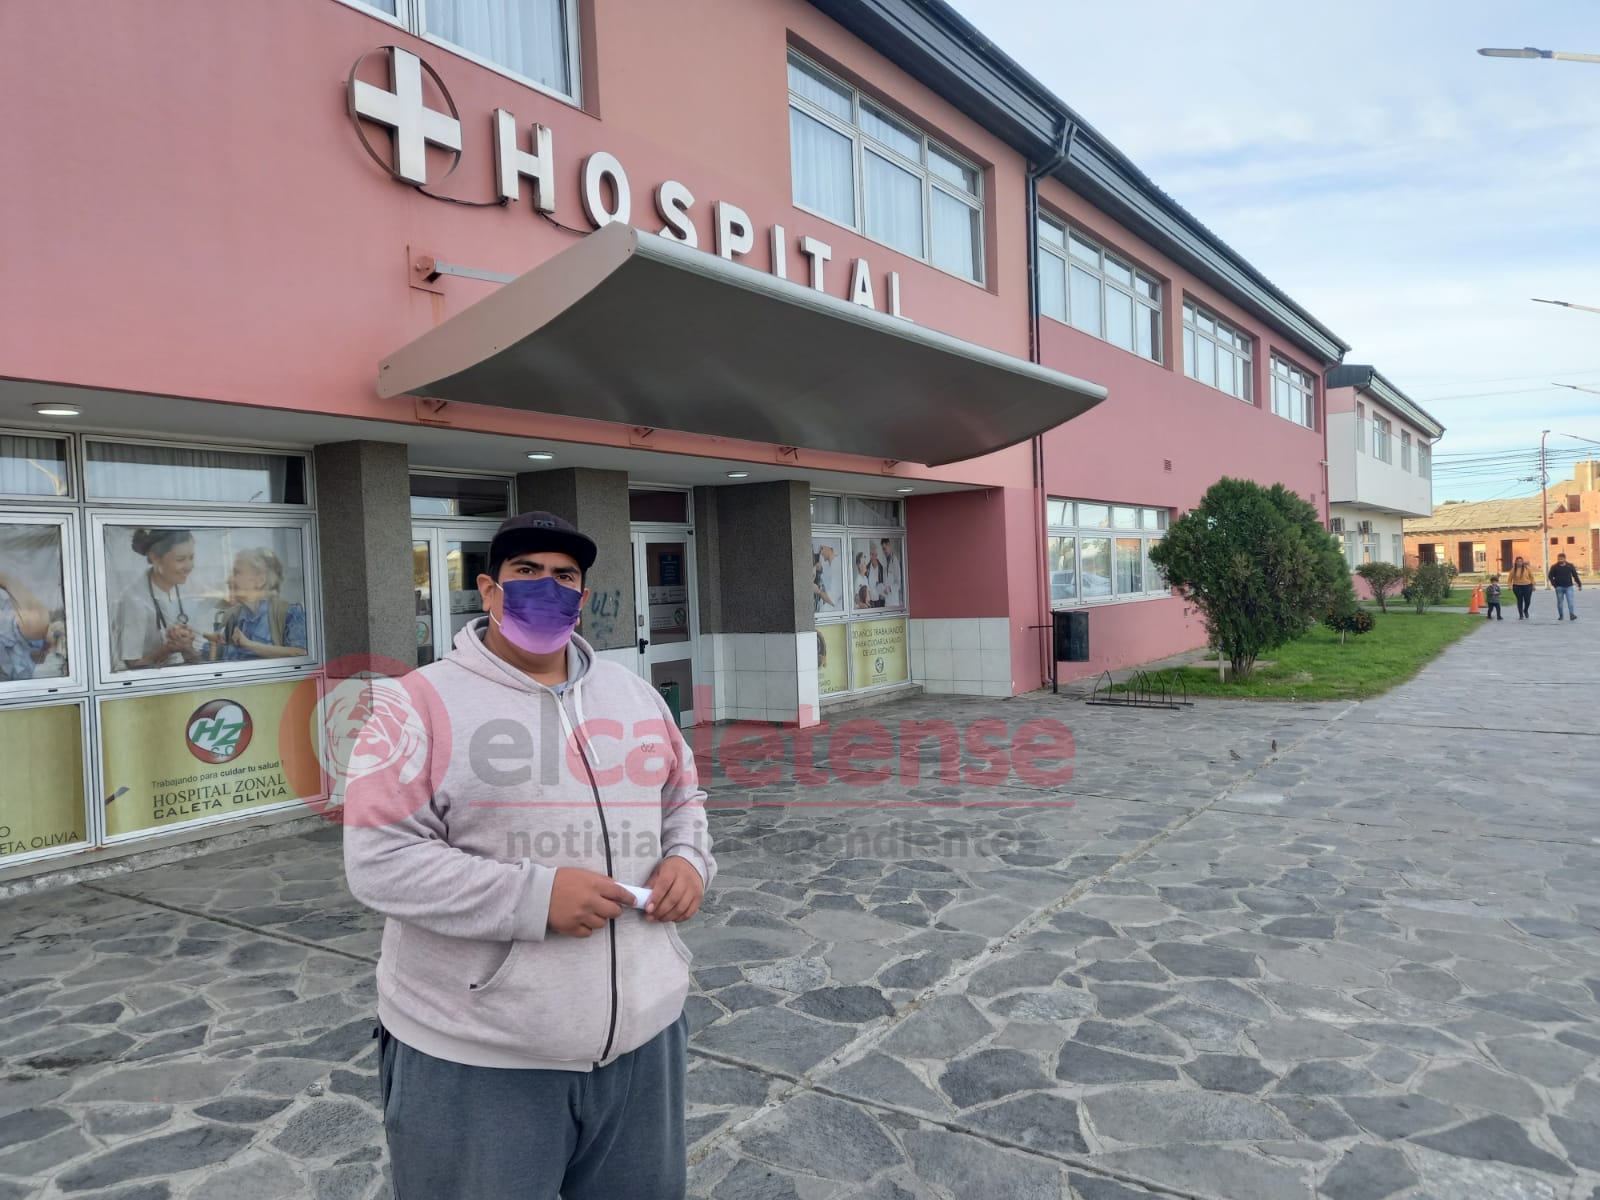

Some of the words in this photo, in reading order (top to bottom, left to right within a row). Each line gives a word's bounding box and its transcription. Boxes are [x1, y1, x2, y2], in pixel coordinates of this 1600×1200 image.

[494, 107, 913, 323] HOSPITAL
[191, 718, 249, 747] HZ
[152, 775, 198, 789] Trabajando
[200, 771, 218, 781] para
[220, 766, 246, 777] cuidar
[247, 765, 256, 773] tu
[152, 783, 231, 808] HOSPITAL
[235, 773, 286, 793] ZONAL
[153, 799, 222, 820] CALETA
[233, 786, 287, 804] OLIVIA
[30, 831, 79, 849] OLIVIA
